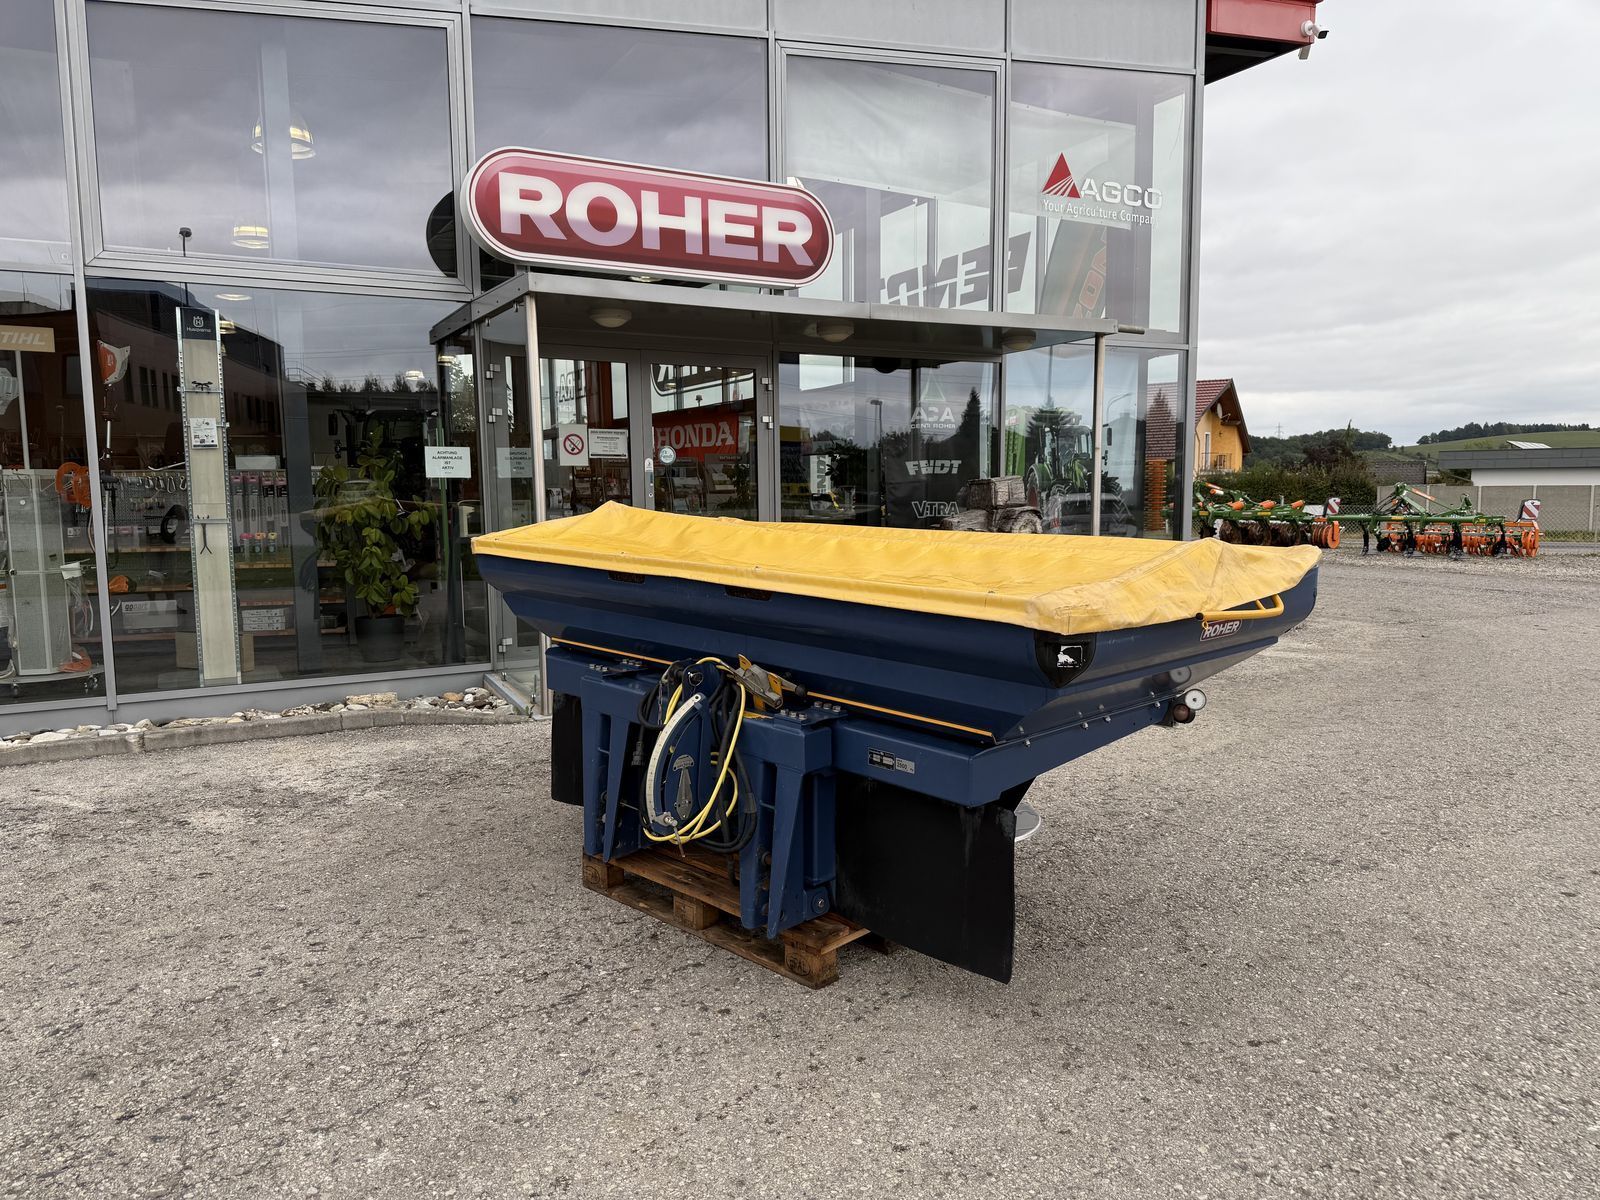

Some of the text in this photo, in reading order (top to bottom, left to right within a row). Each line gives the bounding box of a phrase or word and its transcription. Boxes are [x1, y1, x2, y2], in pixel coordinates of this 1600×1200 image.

[1043, 199, 1064, 213] Your
[1080, 178, 1162, 210] AGCO
[499, 171, 814, 267] ROHER
[0, 331, 46, 345] TIHL
[655, 421, 735, 450] HONDA
[1202, 620, 1240, 639] ROHER
